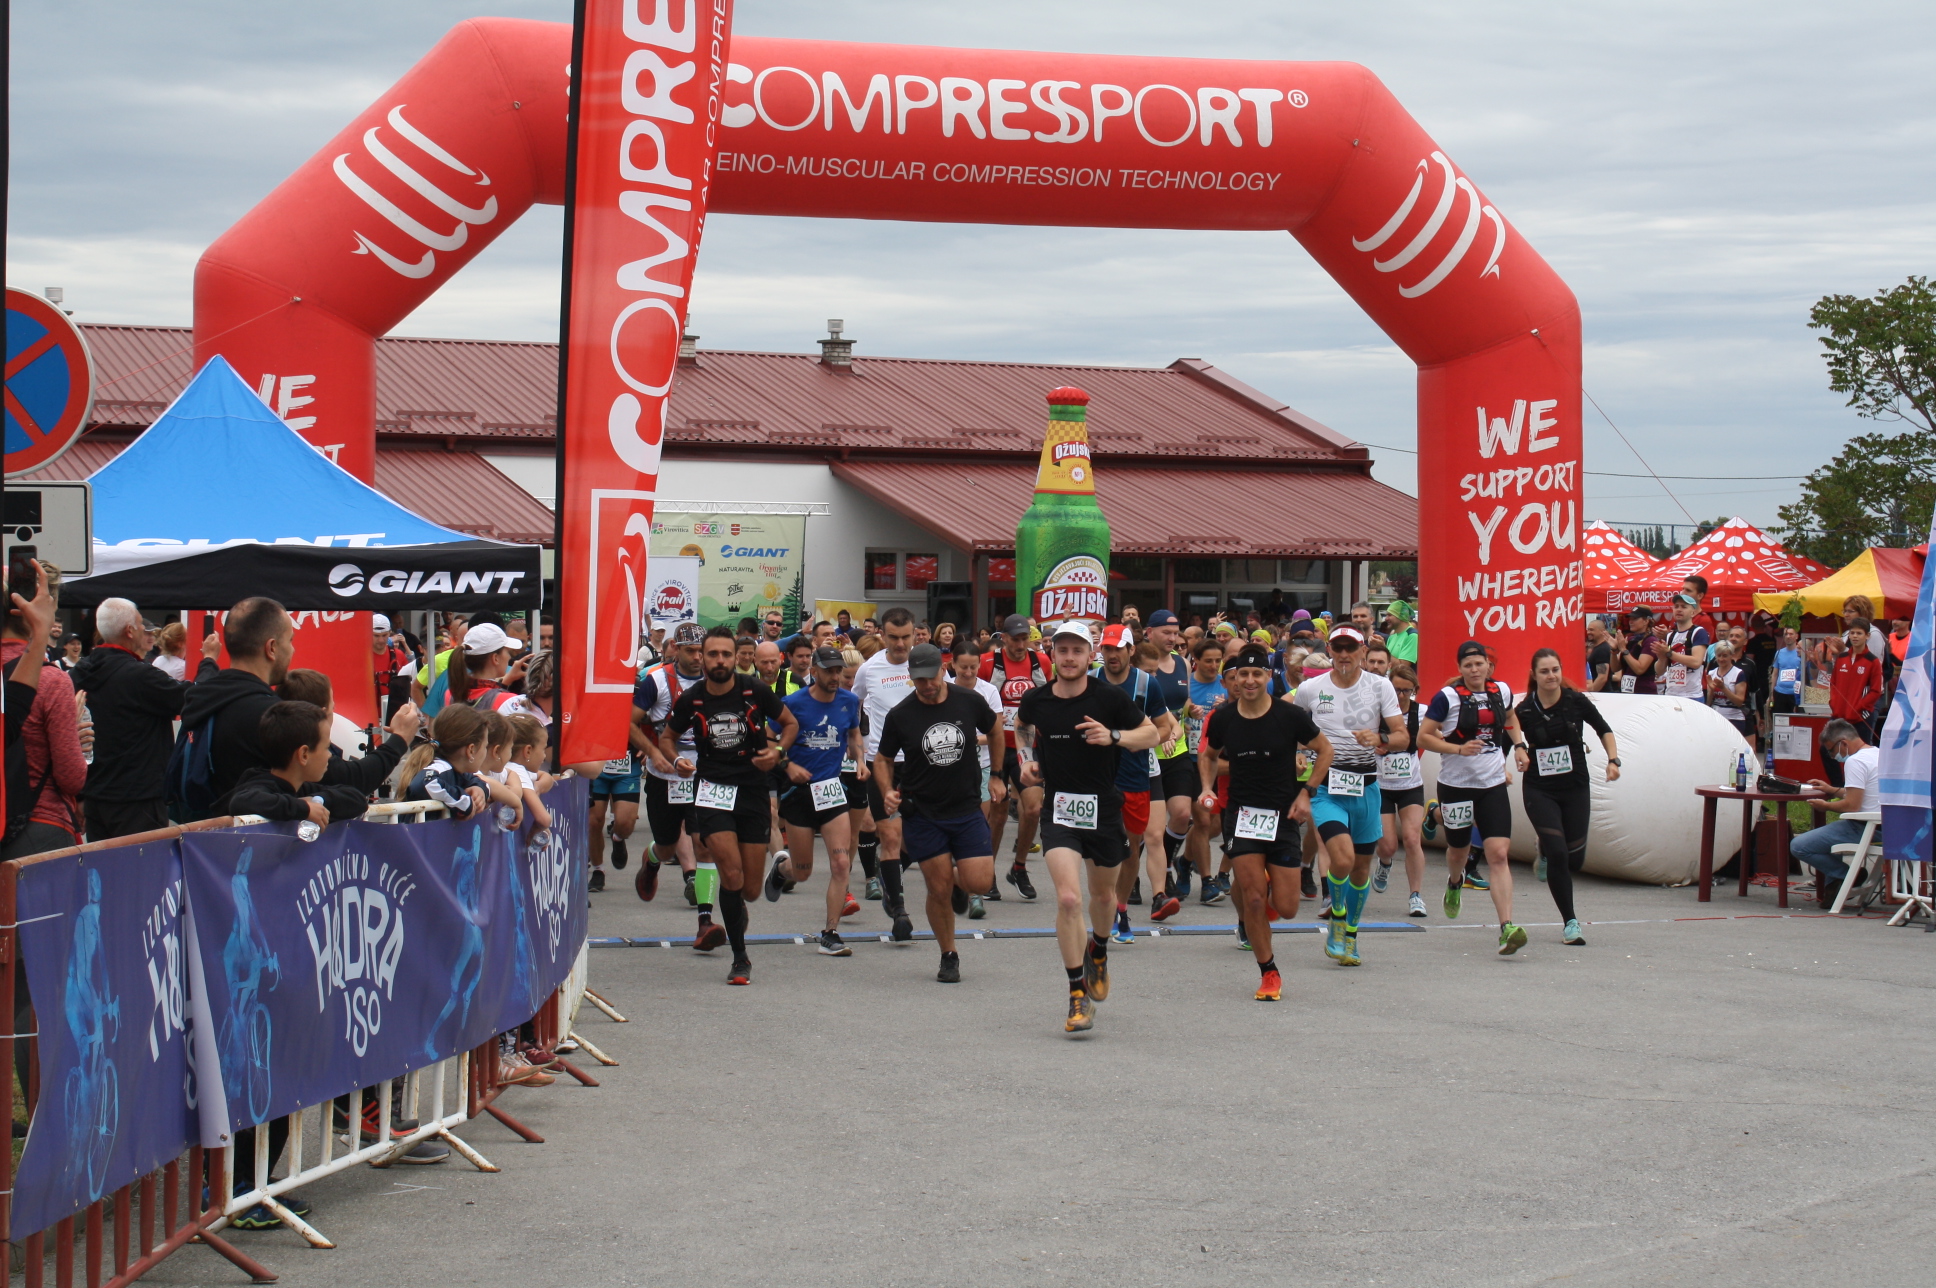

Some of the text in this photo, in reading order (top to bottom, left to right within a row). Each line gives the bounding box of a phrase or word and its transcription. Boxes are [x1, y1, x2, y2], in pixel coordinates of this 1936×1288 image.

[716, 152, 1282, 191] EINO-MUSCULAR COMPRESSION TECHNOLOGY
[1476, 399, 1560, 459] WE
[1460, 460, 1577, 502] SUPPORT
[1468, 499, 1576, 566] YOU
[734, 548, 790, 558] GIANT
[368, 570, 525, 594] GIANT
[1457, 559, 1585, 603] WHEREVER
[657, 592, 683, 605] Trail
[1040, 587, 1107, 619] Ožujsk
[1464, 593, 1584, 637] YOU RACE
[1391, 757, 1410, 771] 423
[1547, 749, 1569, 766] 474
[677, 780, 693, 794] 48
[1340, 773, 1362, 786] 452
[708, 784, 735, 801] 433
[822, 782, 842, 799] 409
[1066, 799, 1095, 818] 469
[1449, 805, 1472, 820] 475
[1249, 813, 1276, 831] 473
[380, 862, 417, 906] PIĆE
[344, 986, 381, 1058] ISO
